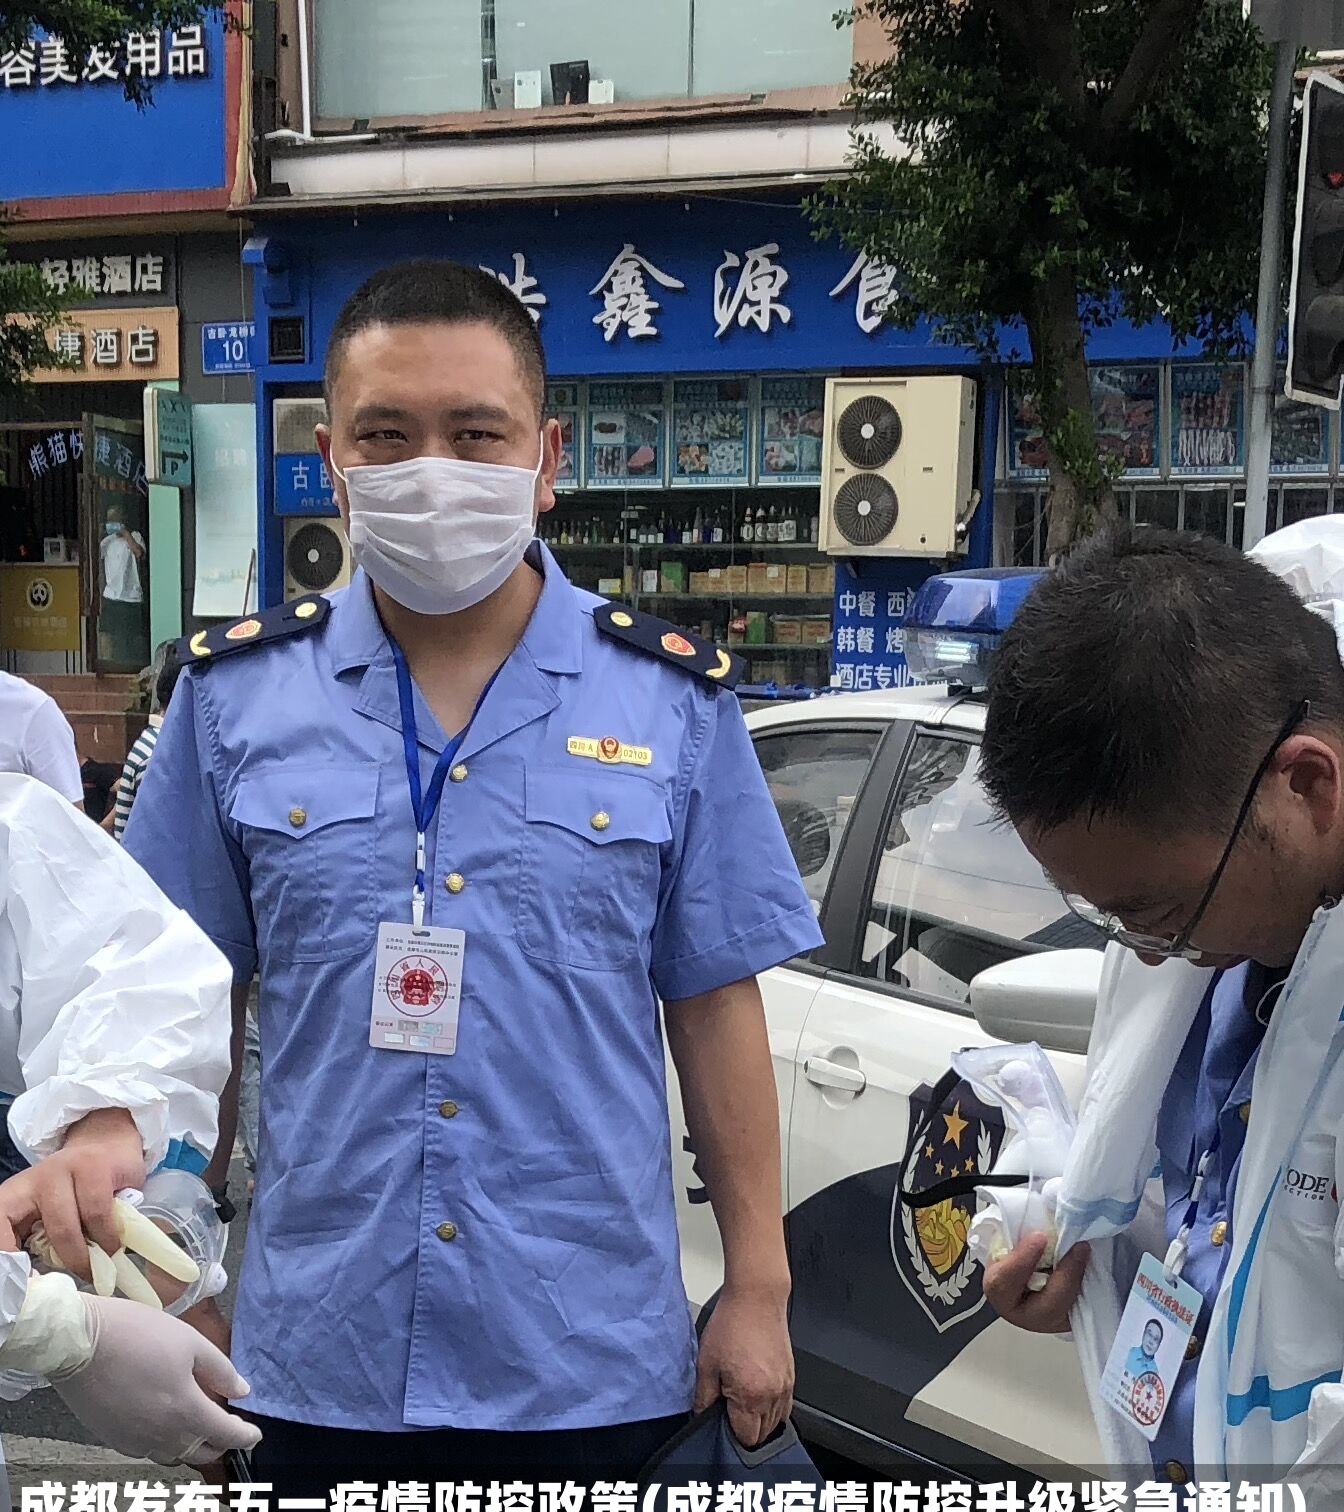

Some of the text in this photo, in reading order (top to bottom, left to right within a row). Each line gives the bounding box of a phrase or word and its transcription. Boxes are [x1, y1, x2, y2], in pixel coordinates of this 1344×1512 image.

[222, 340, 245, 361] 10
[839, 589, 876, 618] 中餐
[836, 625, 875, 654] 韩餐
